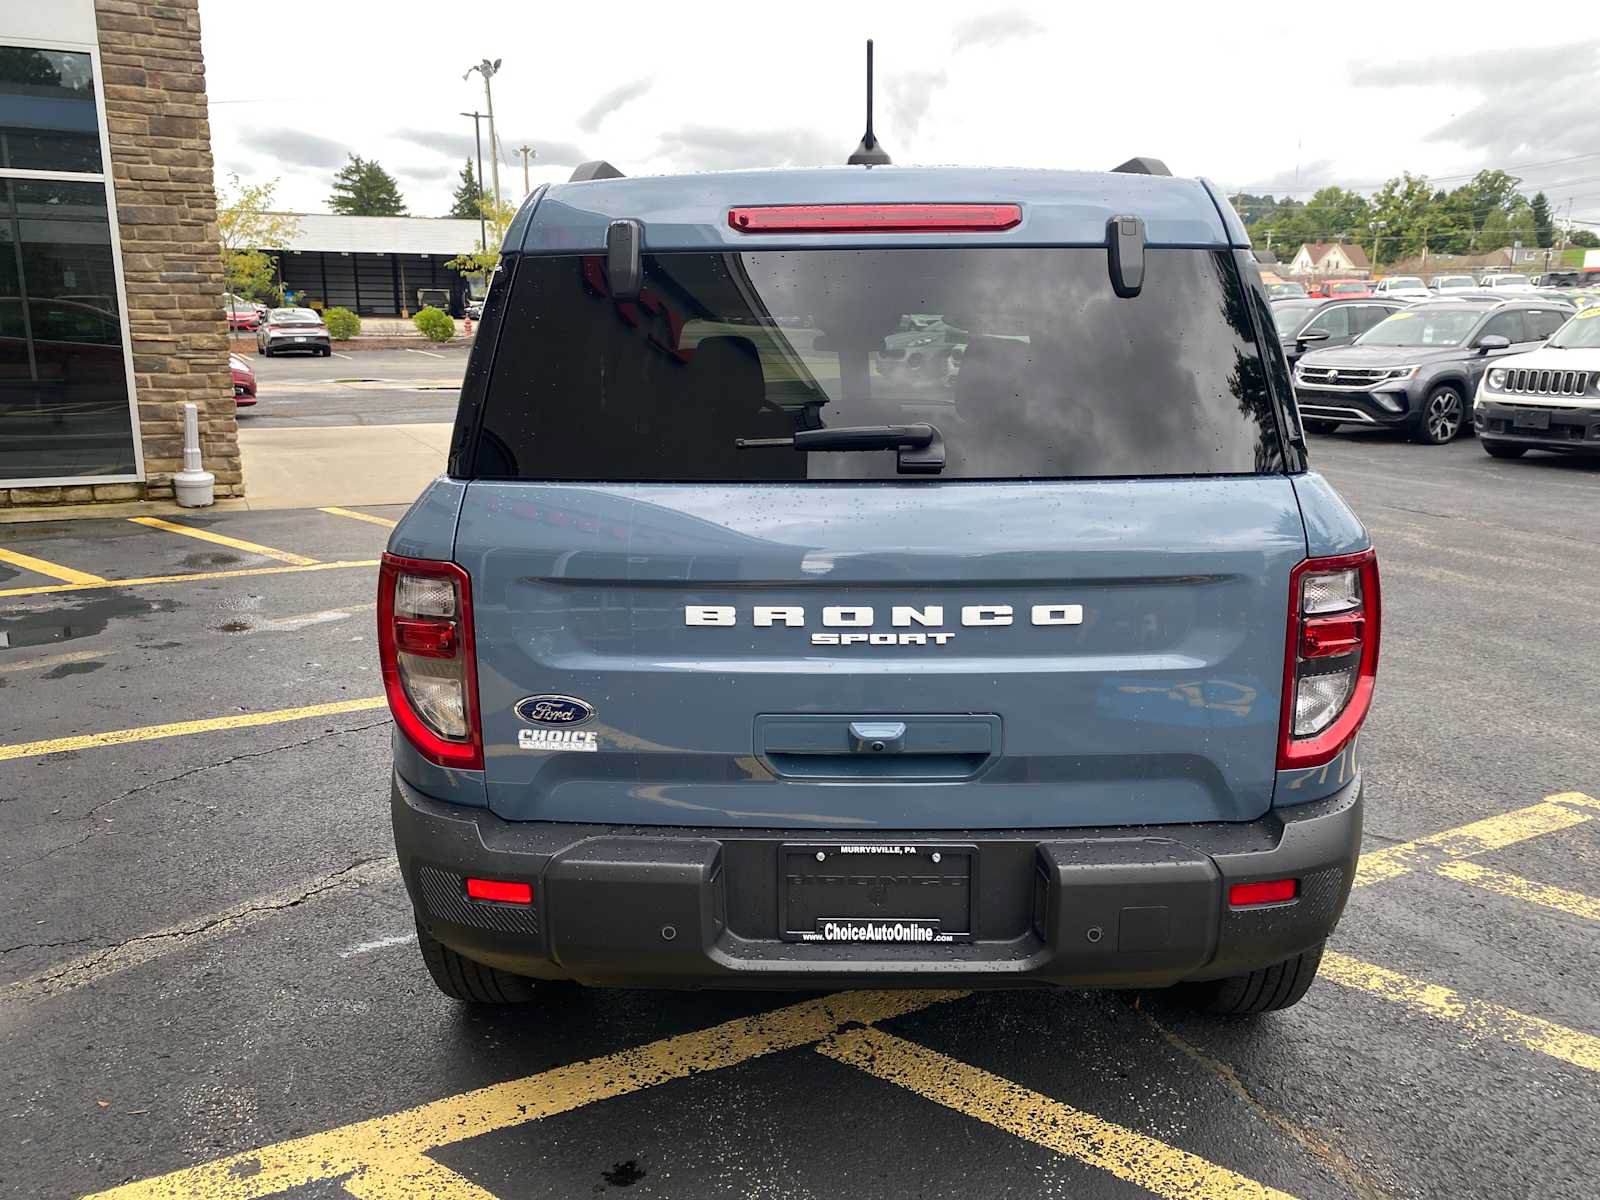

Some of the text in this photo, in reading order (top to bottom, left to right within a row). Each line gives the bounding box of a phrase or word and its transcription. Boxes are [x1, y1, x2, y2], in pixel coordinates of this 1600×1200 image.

[685, 604, 1083, 627] BRONCO
[811, 632, 955, 645] SPORT
[518, 728, 598, 742] CHOICE
[841, 846, 916, 854] MURRYSVILLE, PA
